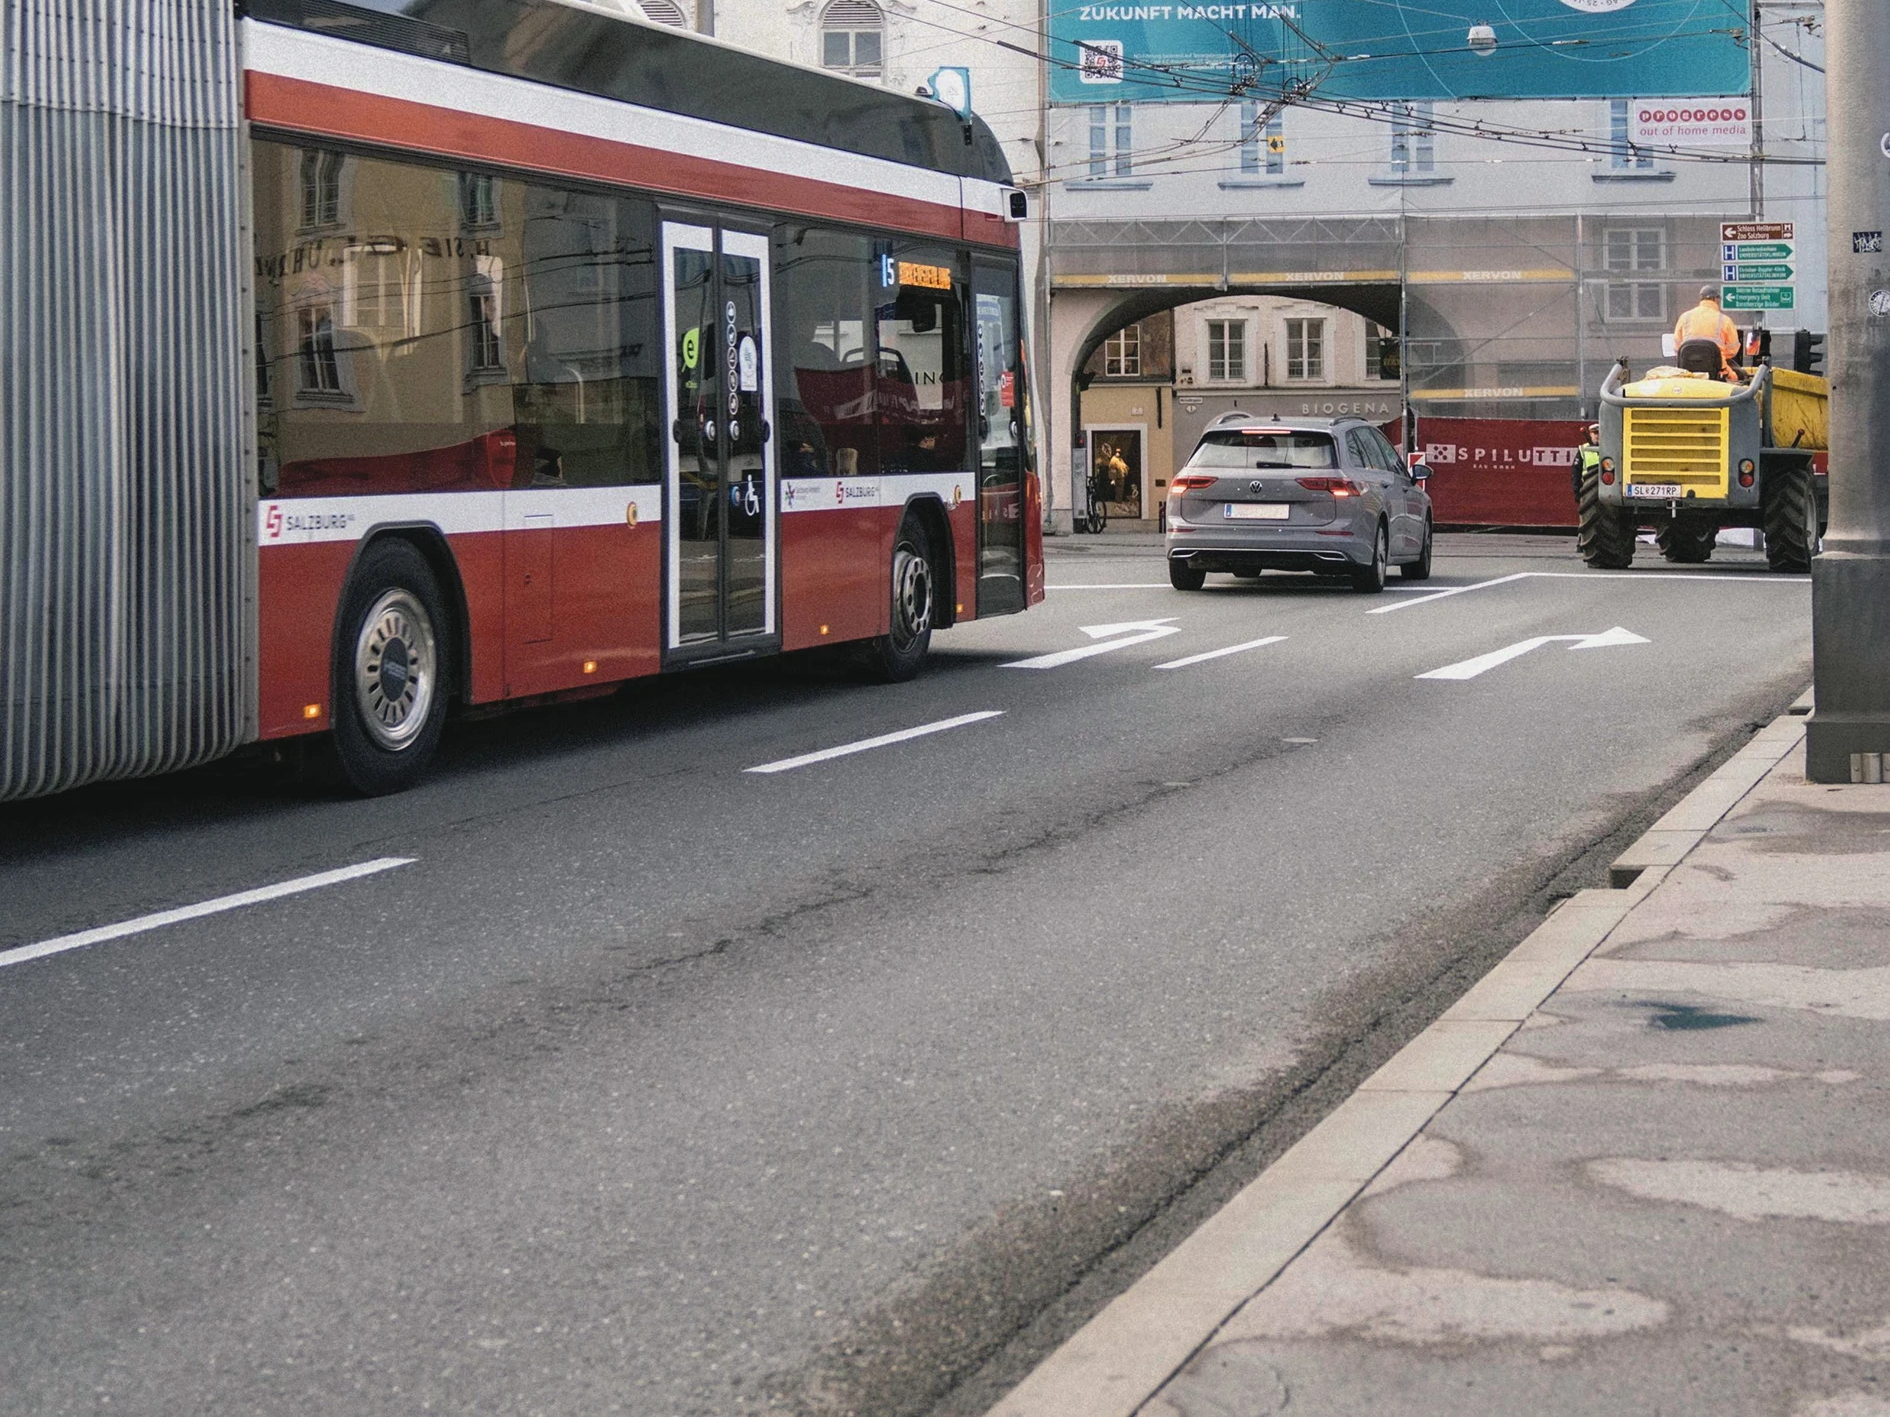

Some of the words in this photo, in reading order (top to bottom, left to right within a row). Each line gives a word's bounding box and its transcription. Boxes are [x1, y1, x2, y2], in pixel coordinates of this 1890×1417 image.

[1079, 6, 1172, 21] ZUKUNFT
[1176, 5, 1246, 20] MACHT
[1251, 5, 1301, 19] MAN.
[1639, 109, 1746, 122] progress
[1640, 127, 1658, 136] out
[1662, 126, 1673, 135] of
[1678, 126, 1708, 135] home
[1712, 125, 1746, 134] media
[1725, 246, 1734, 260] H
[887, 257, 895, 285] 5
[1285, 271, 1345, 281] XERVON
[1463, 270, 1522, 280] XERVON
[1726, 266, 1735, 280] H
[1108, 274, 1167, 283] XERVON
[1464, 387, 1524, 397] XERVON
[1302, 402, 1389, 415] BIOGENA
[1458, 447, 1571, 464] SPILUTTI
[1634, 486, 1645, 495] SL
[1650, 486, 1677, 495] 271RP
[286, 513, 346, 531] SALZBURG
